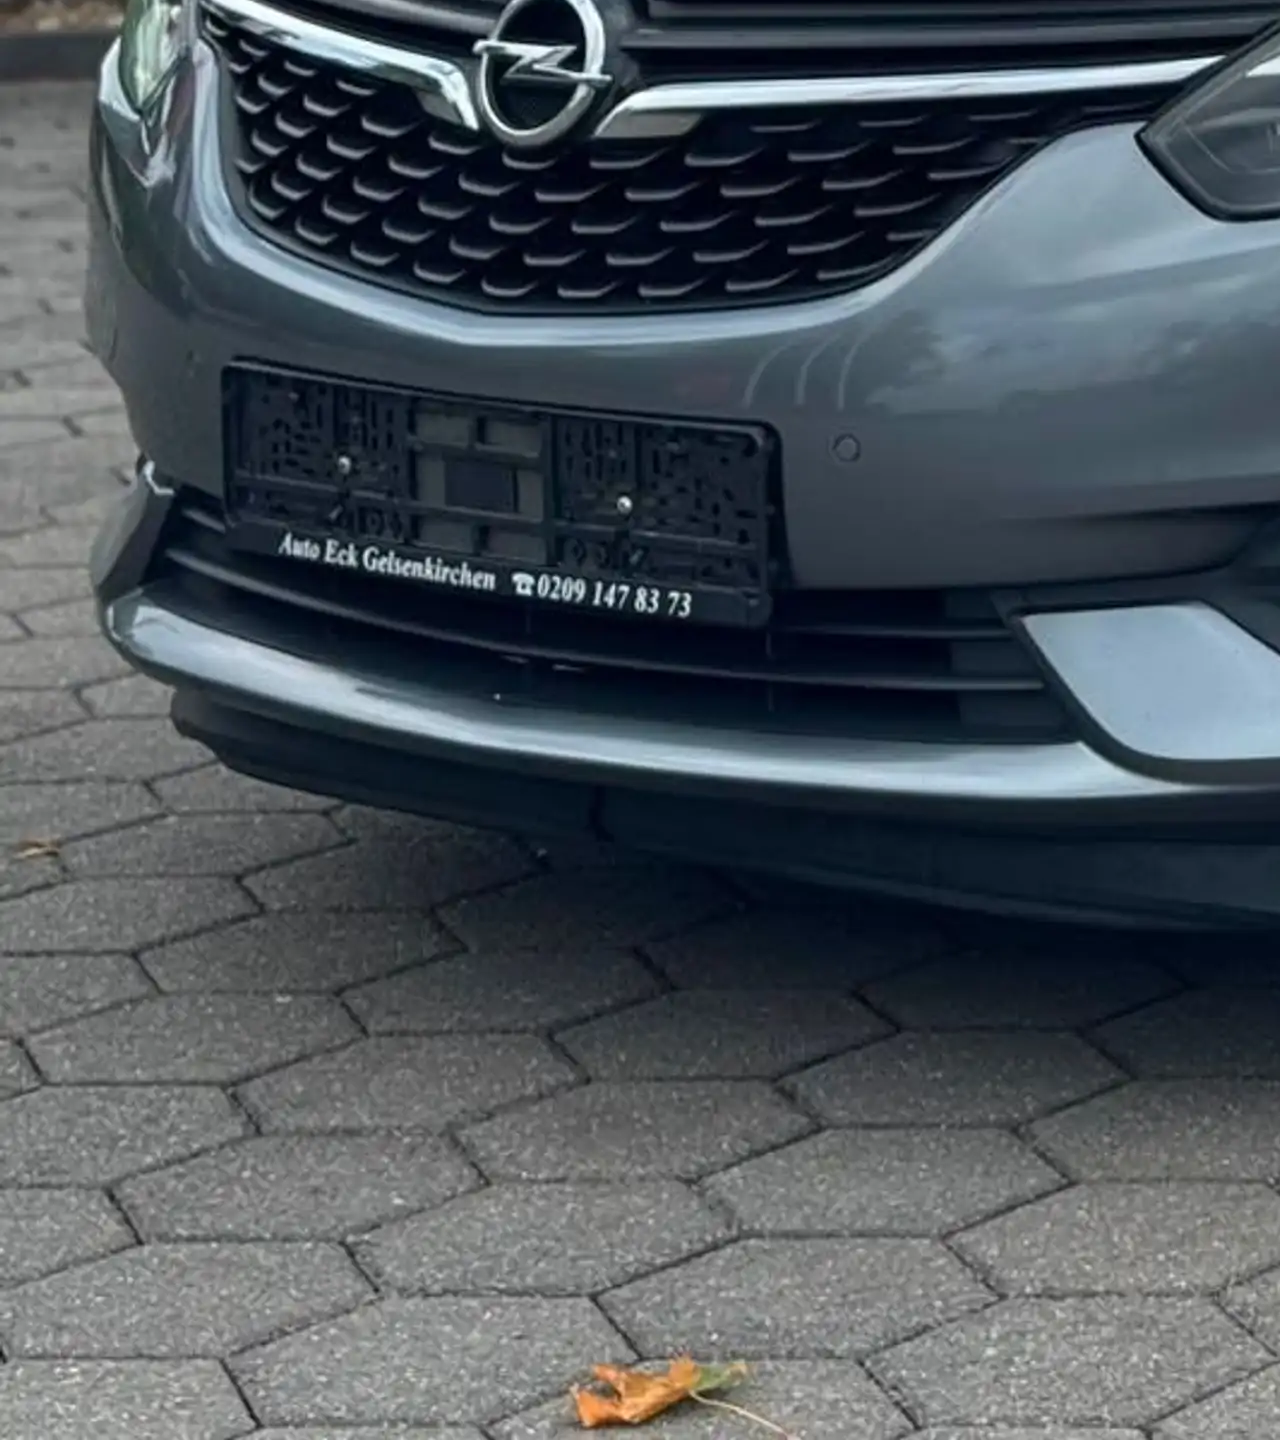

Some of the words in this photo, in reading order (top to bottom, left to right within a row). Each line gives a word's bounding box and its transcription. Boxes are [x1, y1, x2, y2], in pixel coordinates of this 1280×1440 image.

[278, 531, 320, 561] Auto
[324, 538, 359, 569] Eck
[361, 546, 496, 591] Gelsenkirchen
[537, 573, 586, 604] 0209
[592, 580, 630, 609] 147
[634, 586, 660, 614] 83
[667, 591, 692, 618] 73
